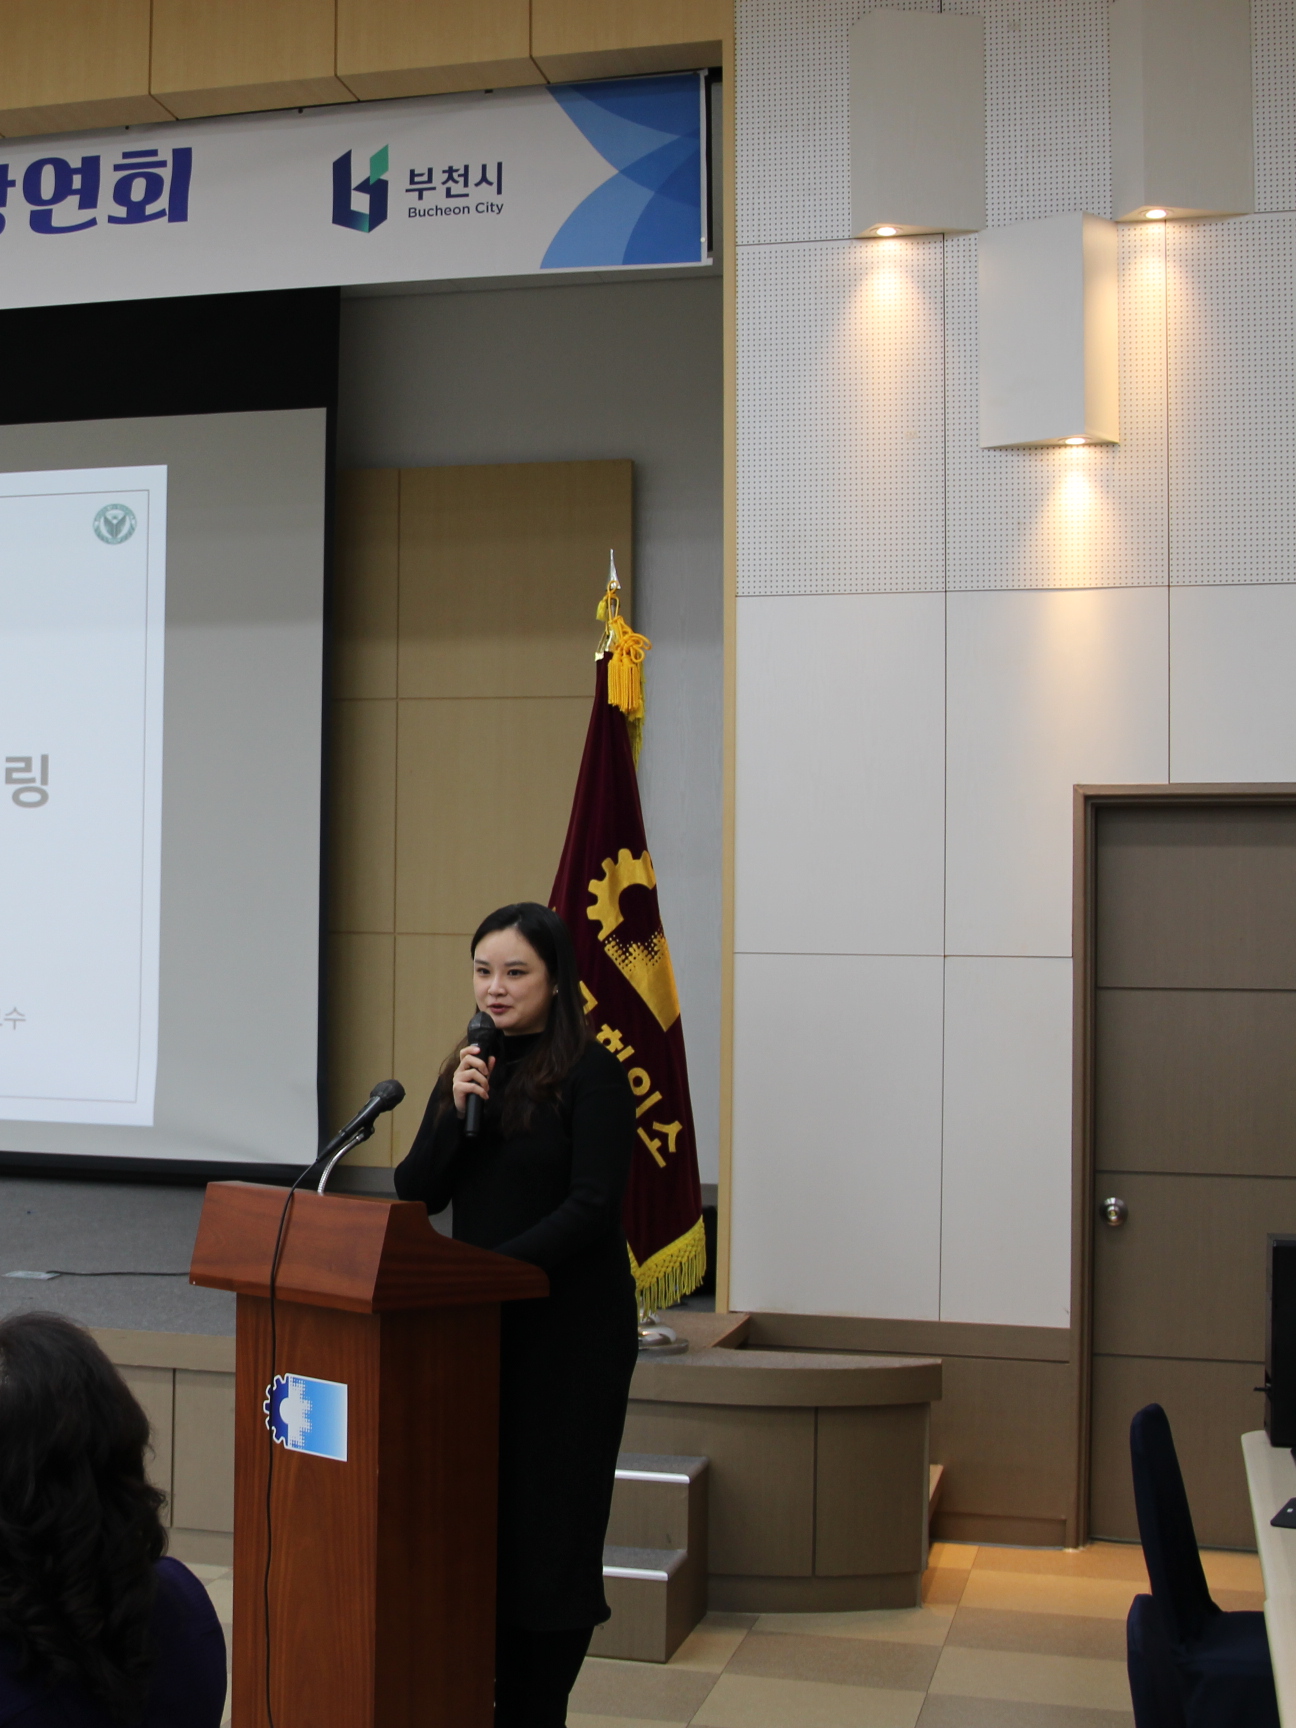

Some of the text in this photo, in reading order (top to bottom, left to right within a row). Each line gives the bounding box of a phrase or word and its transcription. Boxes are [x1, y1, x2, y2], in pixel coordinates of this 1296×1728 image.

[406, 162, 502, 200] 부천시
[409, 203, 503, 217] Bucheon City
